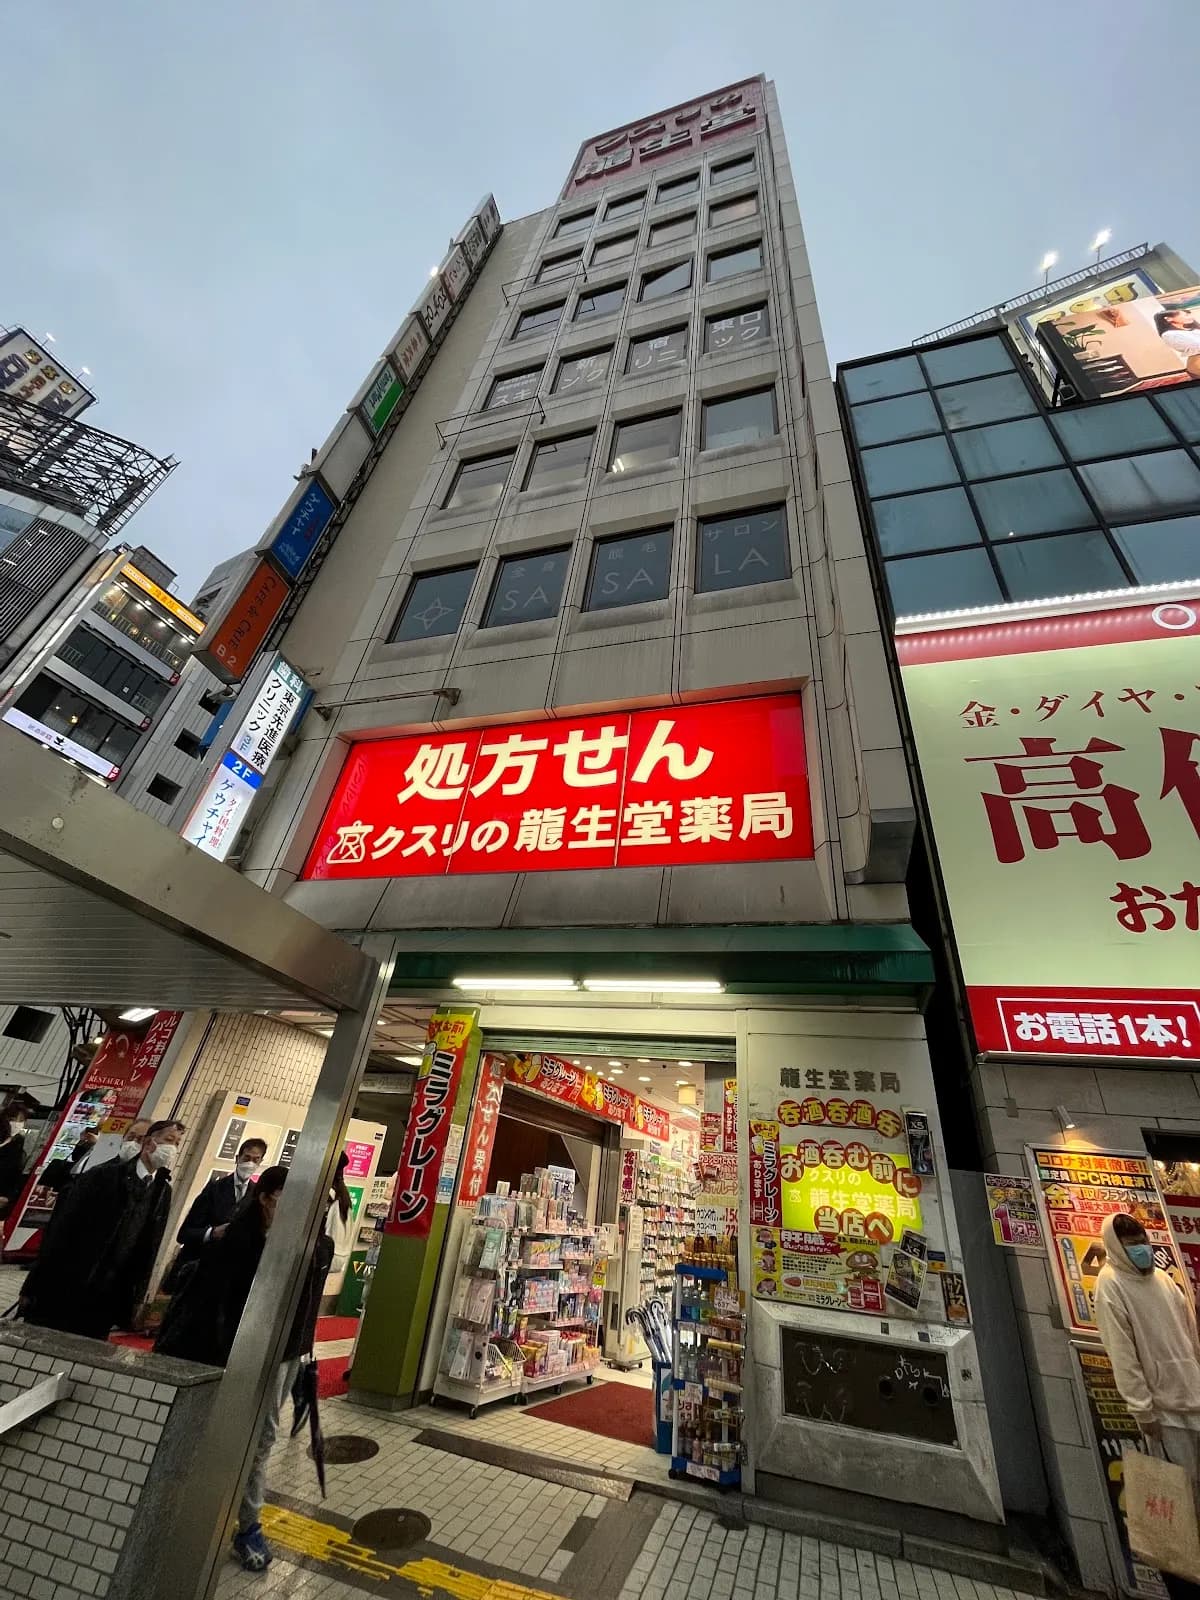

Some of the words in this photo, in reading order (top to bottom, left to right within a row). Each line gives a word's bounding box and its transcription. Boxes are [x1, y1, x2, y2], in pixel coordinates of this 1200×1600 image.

[575, 103, 756, 184] 龍生堂
[276, 659, 304, 694] 歯科
[249, 677, 282, 732] クリニック
[959, 682, 1200, 729] 金・ダイヤ・
[251, 689, 296, 770] 東京先進医療
[231, 760, 253, 779] 2F
[396, 720, 714, 804] 処方せん
[208, 797, 238, 849] タイ国料理
[147, 1011, 178, 1068] ルコ料理
[1013, 1011, 1193, 1048] お電話1本!
[540, 1055, 577, 1086] ミラグレーン
[779, 1067, 901, 1094] 龍生堂薬局
[398, 1051, 457, 1224] ミラグレーン
[780, 1100, 902, 1137] 呑酒呑酒呑
[763, 1140, 779, 1223] ミラグレーン
[781, 1142, 919, 1195] お酒呑む前に
[809, 1170, 862, 1184] クスリの
[809, 1187, 916, 1219] 龍生堂薬局
[817, 1209, 890, 1238] 当店へ
